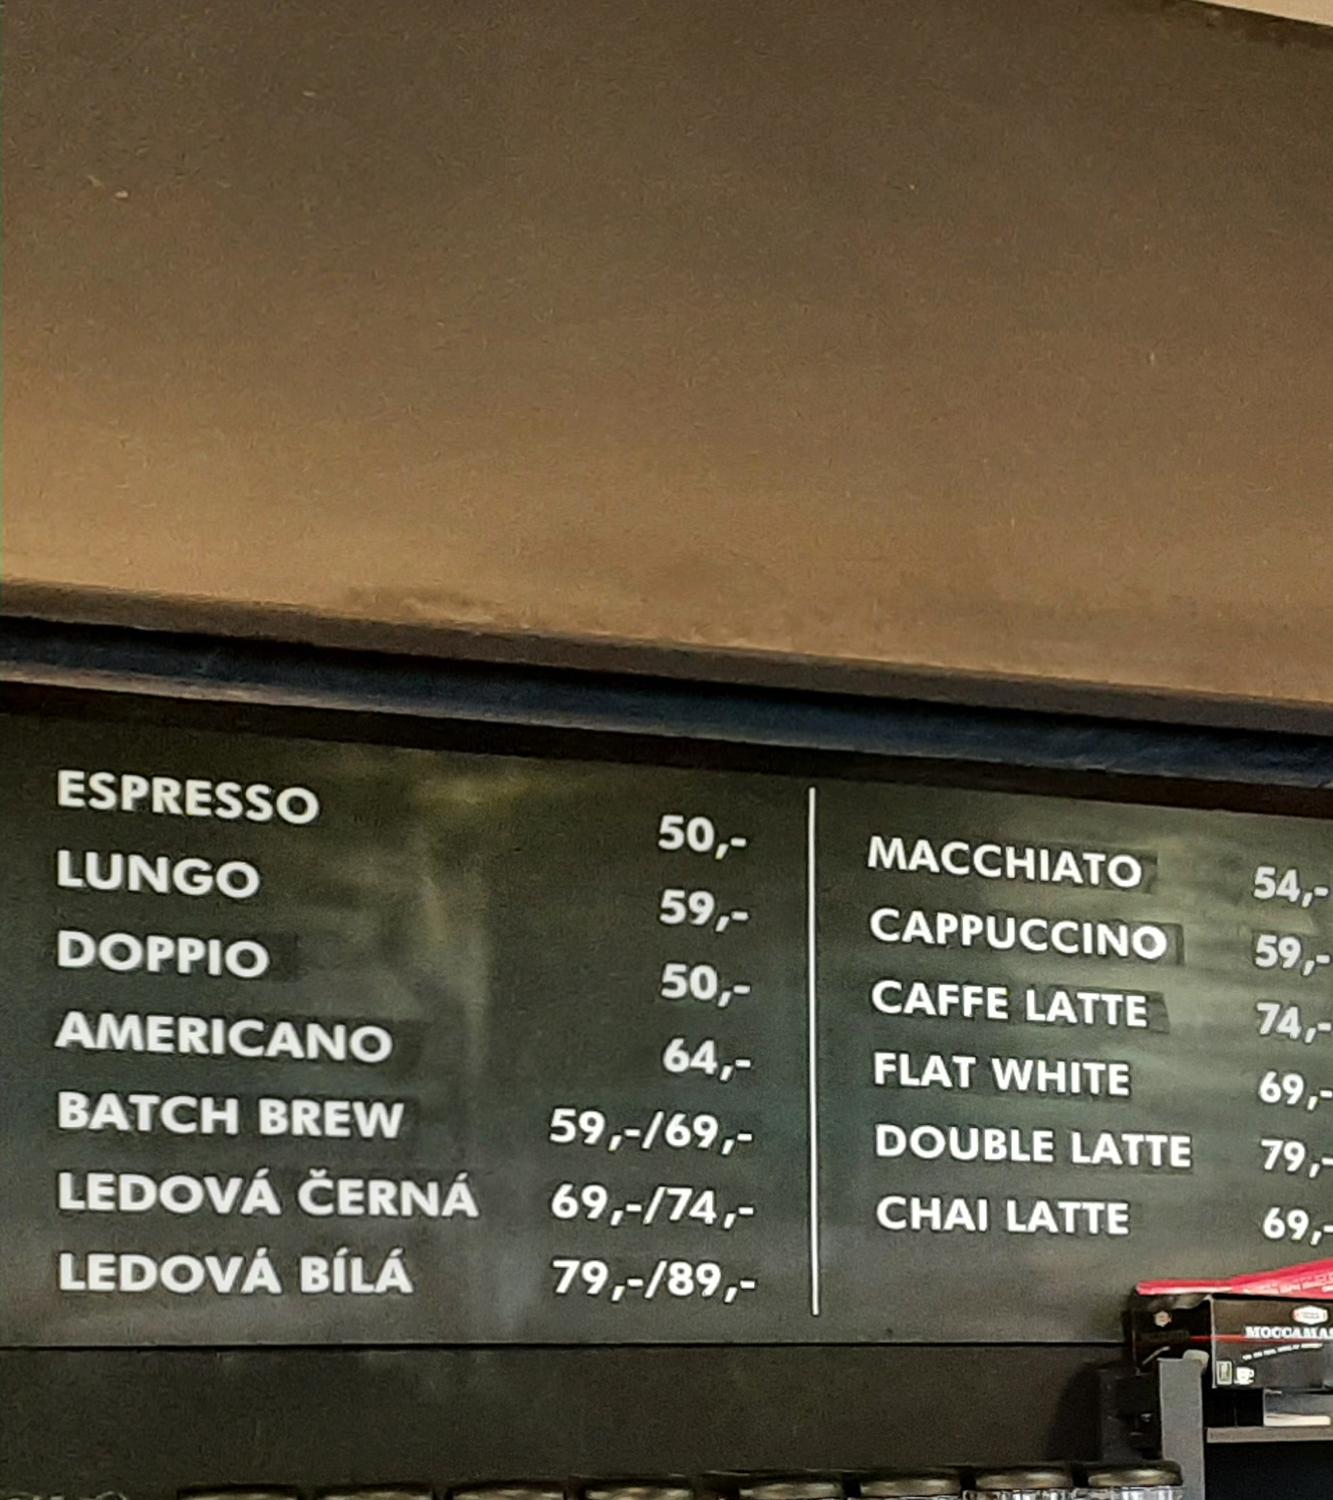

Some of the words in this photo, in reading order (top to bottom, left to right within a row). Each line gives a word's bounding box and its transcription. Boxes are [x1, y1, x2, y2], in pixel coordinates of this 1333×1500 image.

[58, 770, 319, 824] ESPRESSO
[658, 815, 747, 859] 50,-
[58, 850, 260, 898] LUNGO
[868, 835, 1142, 888] MACCHIATO
[1253, 866, 1329, 908] 54,-
[660, 889, 749, 932] 59,-
[58, 930, 269, 978] DOPPIO
[870, 907, 1169, 960] CAPPUCCINO
[1255, 933, 1331, 976] 59,-
[661, 963, 751, 1007] 50,-
[871, 979, 1009, 1020] CAFFE
[1026, 985, 1150, 1028] LATTE
[54, 1011, 392, 1063] AMERICANO
[1256, 1001, 1332, 1044] 74,-
[663, 1038, 751, 1081] 64,-
[874, 1052, 977, 1088] FLAT
[991, 1054, 1133, 1096] WHITE
[1258, 1070, 1333, 1111] 69,-
[58, 1091, 238, 1135] BATCH
[259, 1098, 404, 1138] BREW
[550, 1108, 753, 1155] 59,-/69,-
[875, 1123, 1054, 1163] DOUBLE
[1070, 1131, 1191, 1168] LATTE
[59, 1168, 281, 1215] LEDOVÁ
[298, 1169, 479, 1218] ČERNÁ
[551, 1183, 754, 1229] 69,-/74,-
[876, 1195, 988, 1232] CHAI
[1006, 1199, 1129, 1235] LATTE
[59, 1247, 282, 1294] LEDOVÁ
[300, 1247, 414, 1294] BÍLÁ
[552, 1259, 756, 1303] 79,-/89,-
